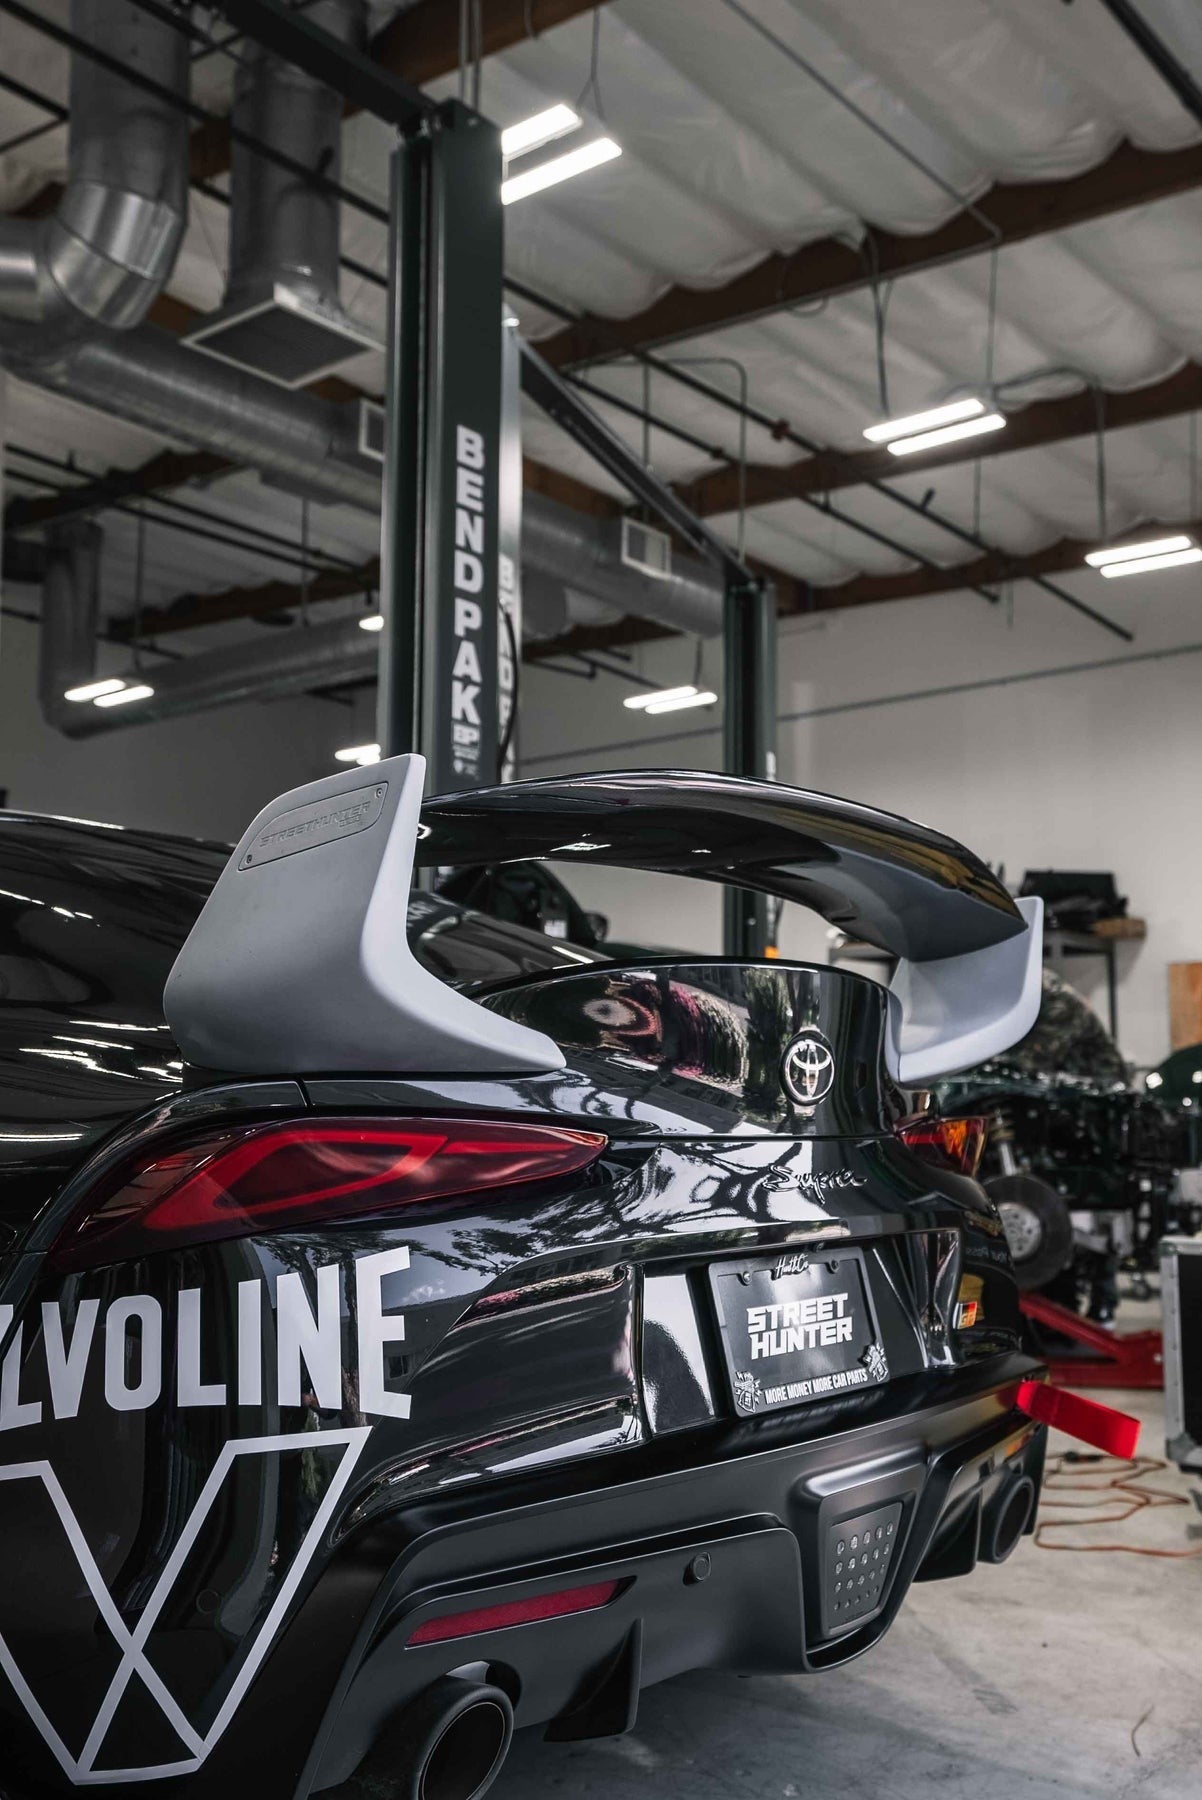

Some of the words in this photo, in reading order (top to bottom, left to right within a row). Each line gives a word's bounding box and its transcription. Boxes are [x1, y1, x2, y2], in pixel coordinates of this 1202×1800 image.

[452, 424, 485, 725] BENDPAK
[260, 801, 371, 848] STREETHUNTER
[762, 1165, 867, 1204] Supra
[746, 1293, 848, 1334] STREET
[750, 1317, 853, 1360] HUNTER
[765, 1387, 788, 1404] MORE
[787, 1382, 813, 1399] MONEY
[813, 1377, 833, 1393] MORE
[832, 1372, 848, 1389] CAR
[847, 1368, 868, 1385] PARTS
